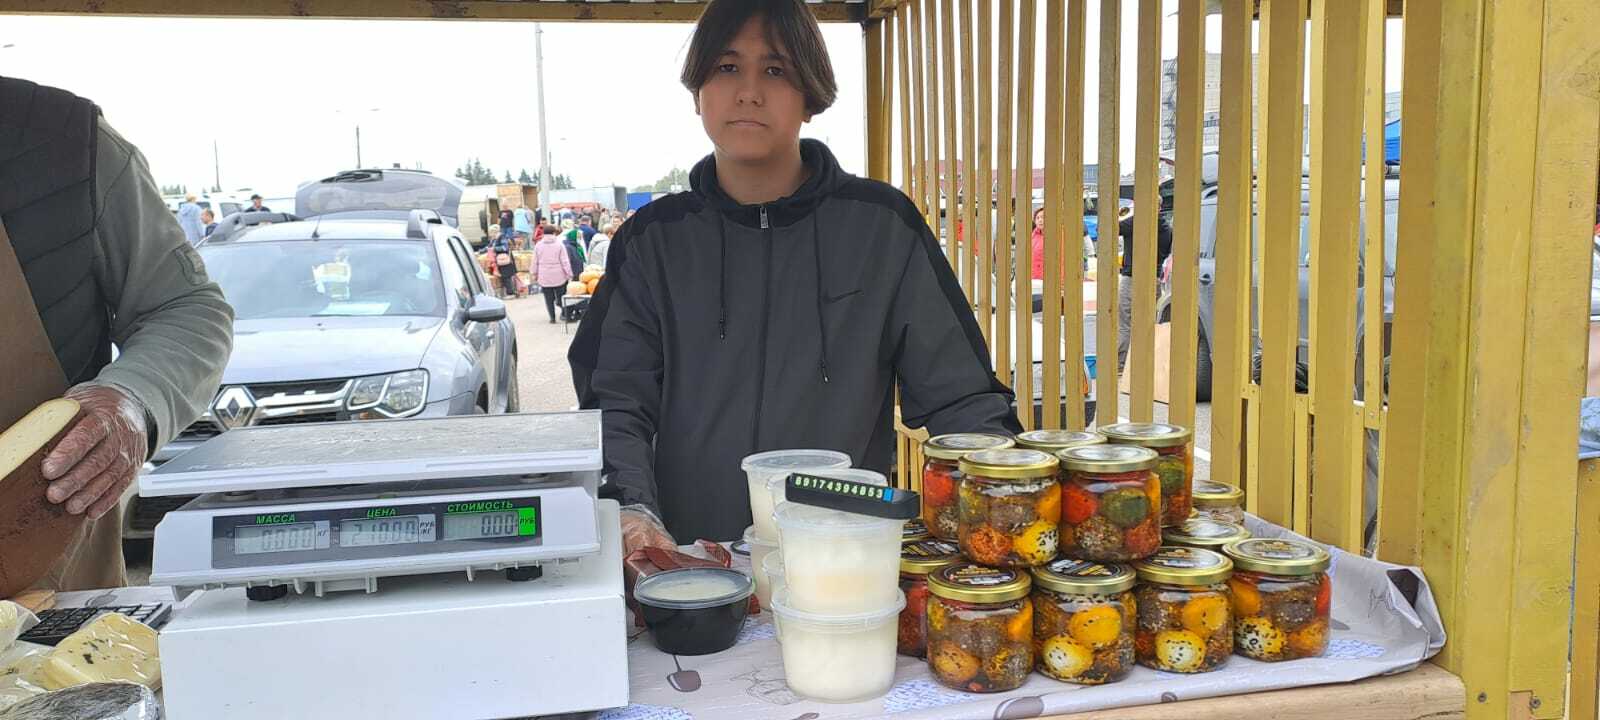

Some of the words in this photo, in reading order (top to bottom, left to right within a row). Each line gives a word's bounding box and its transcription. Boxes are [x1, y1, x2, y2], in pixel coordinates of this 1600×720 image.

[448, 501, 513, 512] СТОИМОСТЬ
[367, 508, 396, 518] ЦЕНА
[256, 514, 296, 525] МАССА
